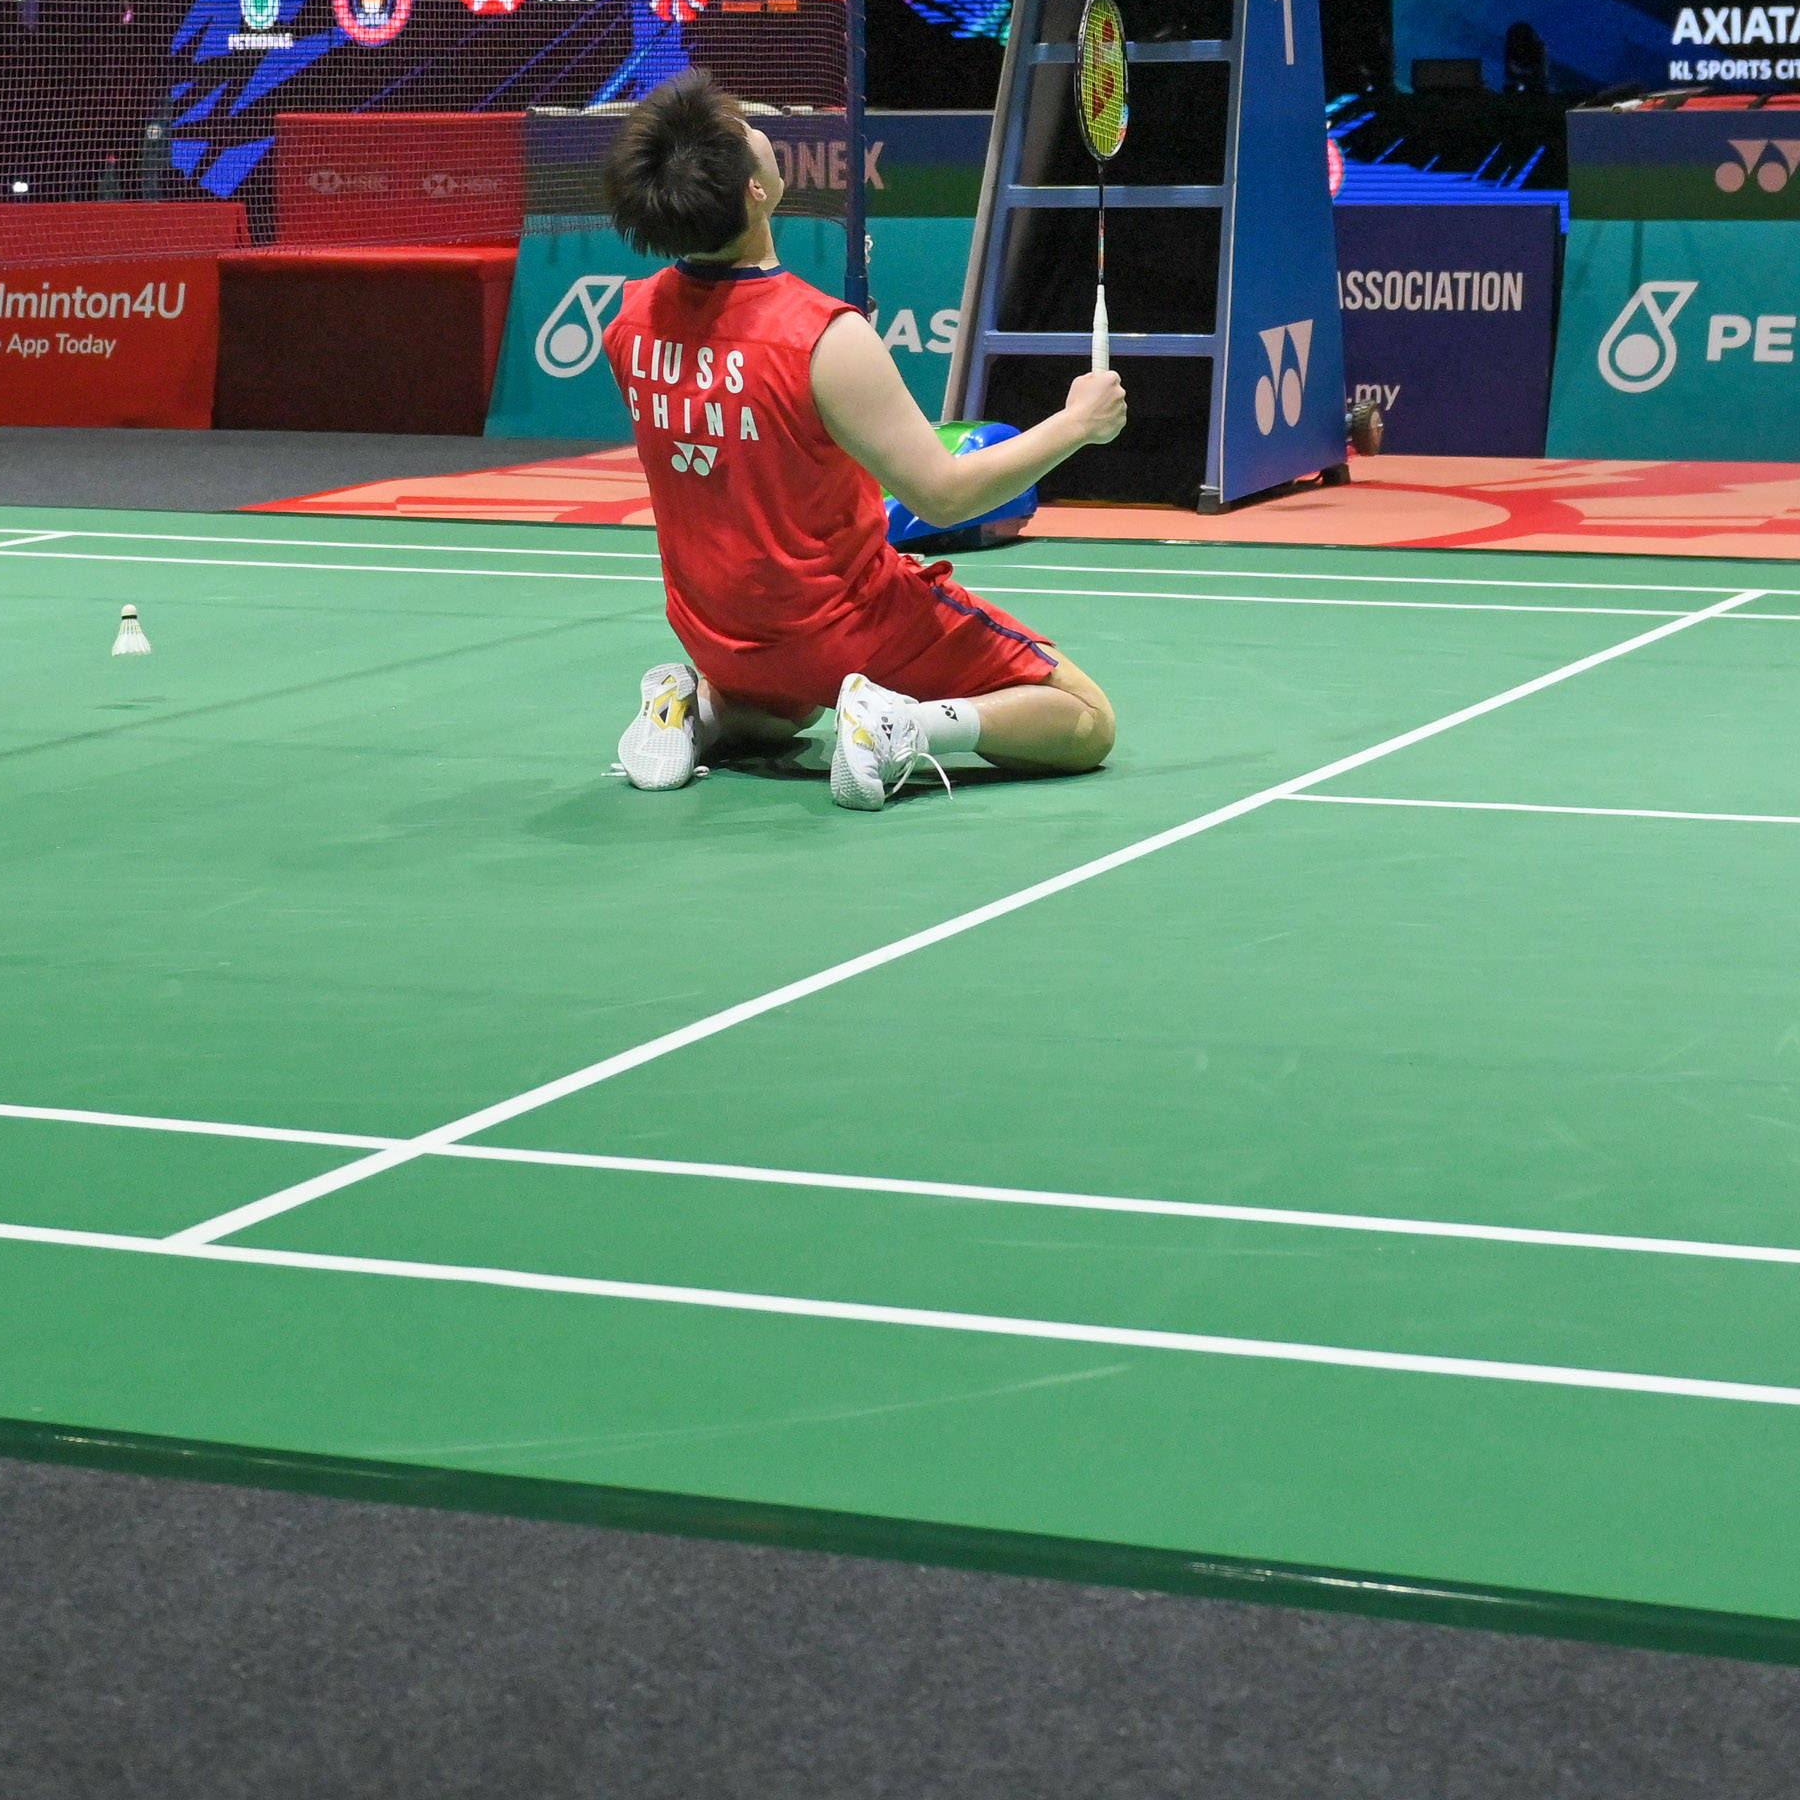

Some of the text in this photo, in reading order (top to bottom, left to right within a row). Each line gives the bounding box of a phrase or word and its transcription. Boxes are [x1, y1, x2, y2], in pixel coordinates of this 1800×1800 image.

[1670, 60, 1692, 80] KL
[1696, 59, 1772, 80] SPORTS
[771, 141, 885, 190] ONEX
[6, 334, 49, 358] App
[55, 334, 116, 358] Today
[631, 334, 681, 385] LIU
[629, 386, 759, 441] CHINA
